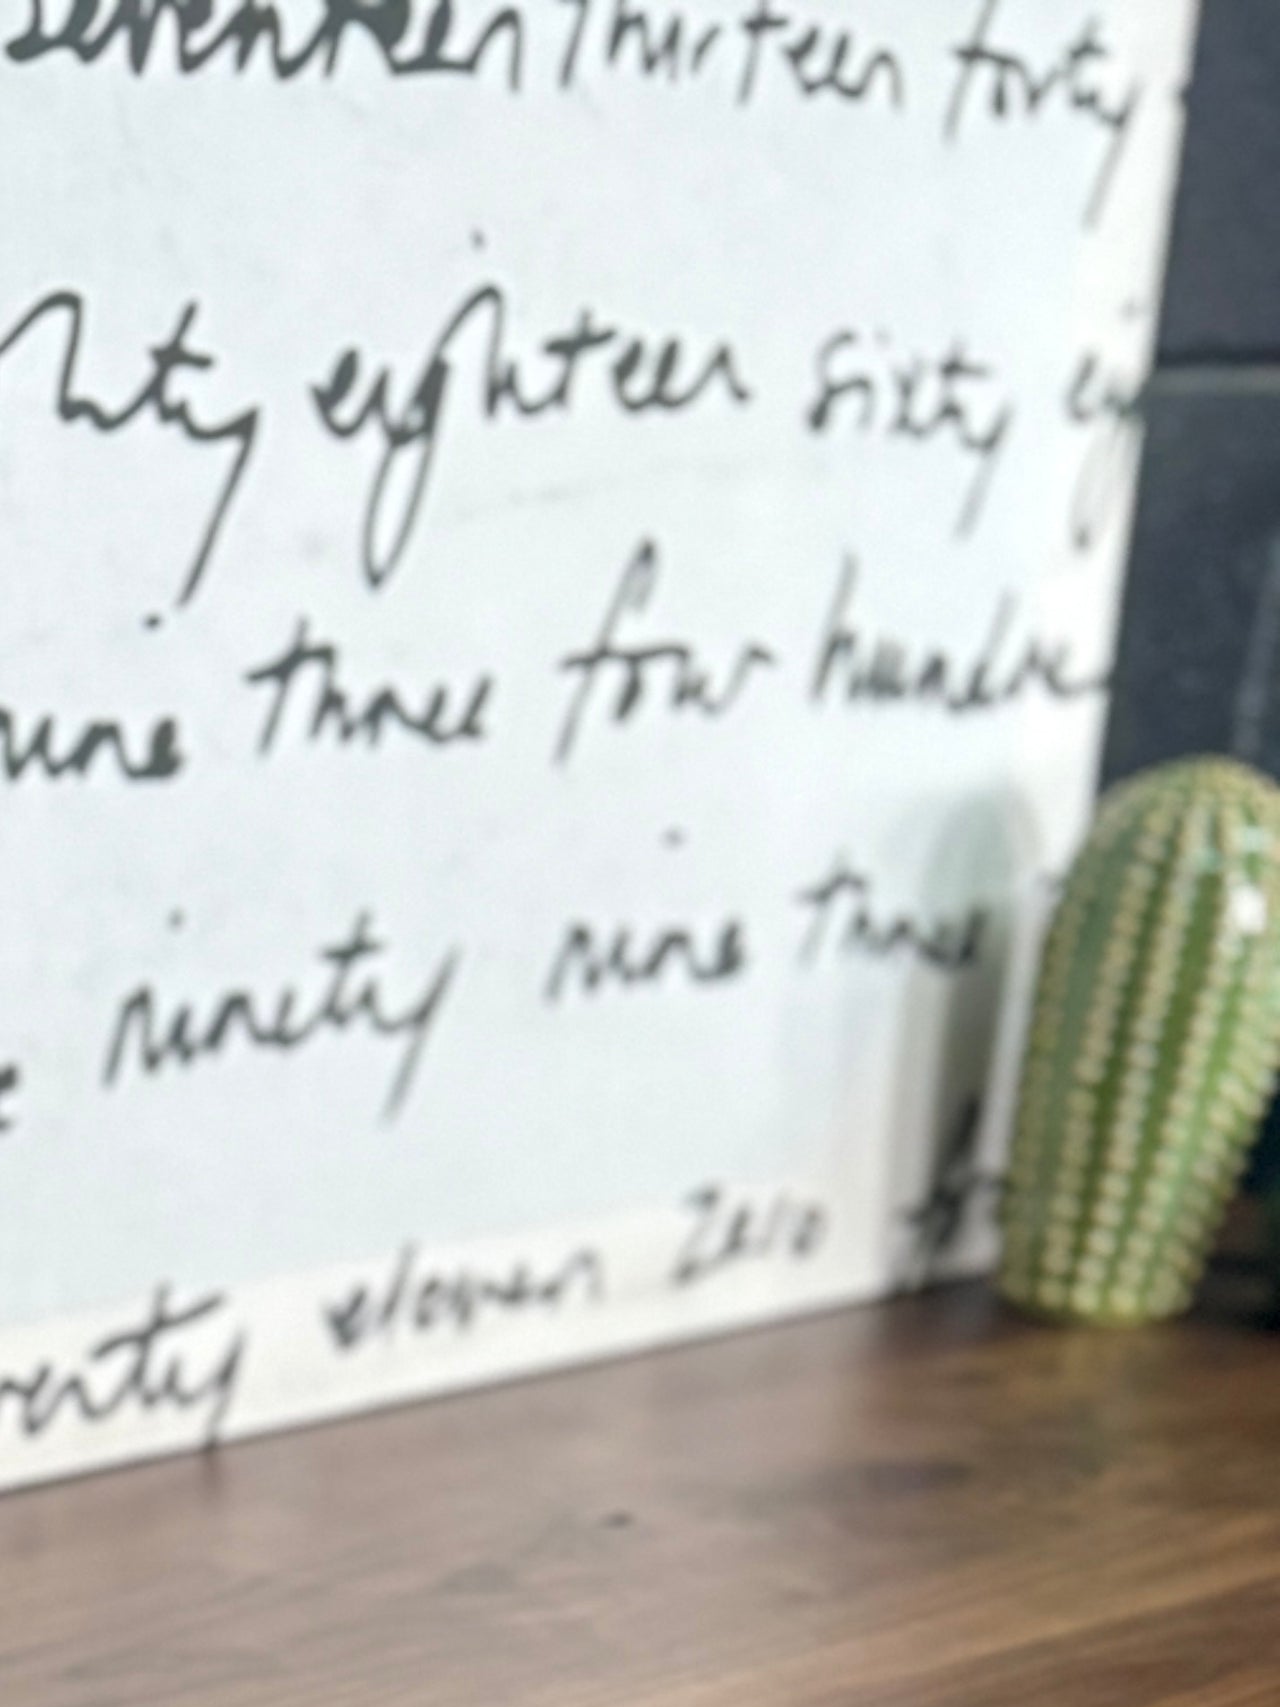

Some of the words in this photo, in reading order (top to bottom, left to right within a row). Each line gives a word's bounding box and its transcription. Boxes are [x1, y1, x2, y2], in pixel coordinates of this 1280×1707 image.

[307, 230, 752, 591] eighteen
[244, 614, 494, 758] three
[557, 539, 777, 766] four
[100, 906, 460, 1128] ninety
[543, 828, 748, 1004] nine
